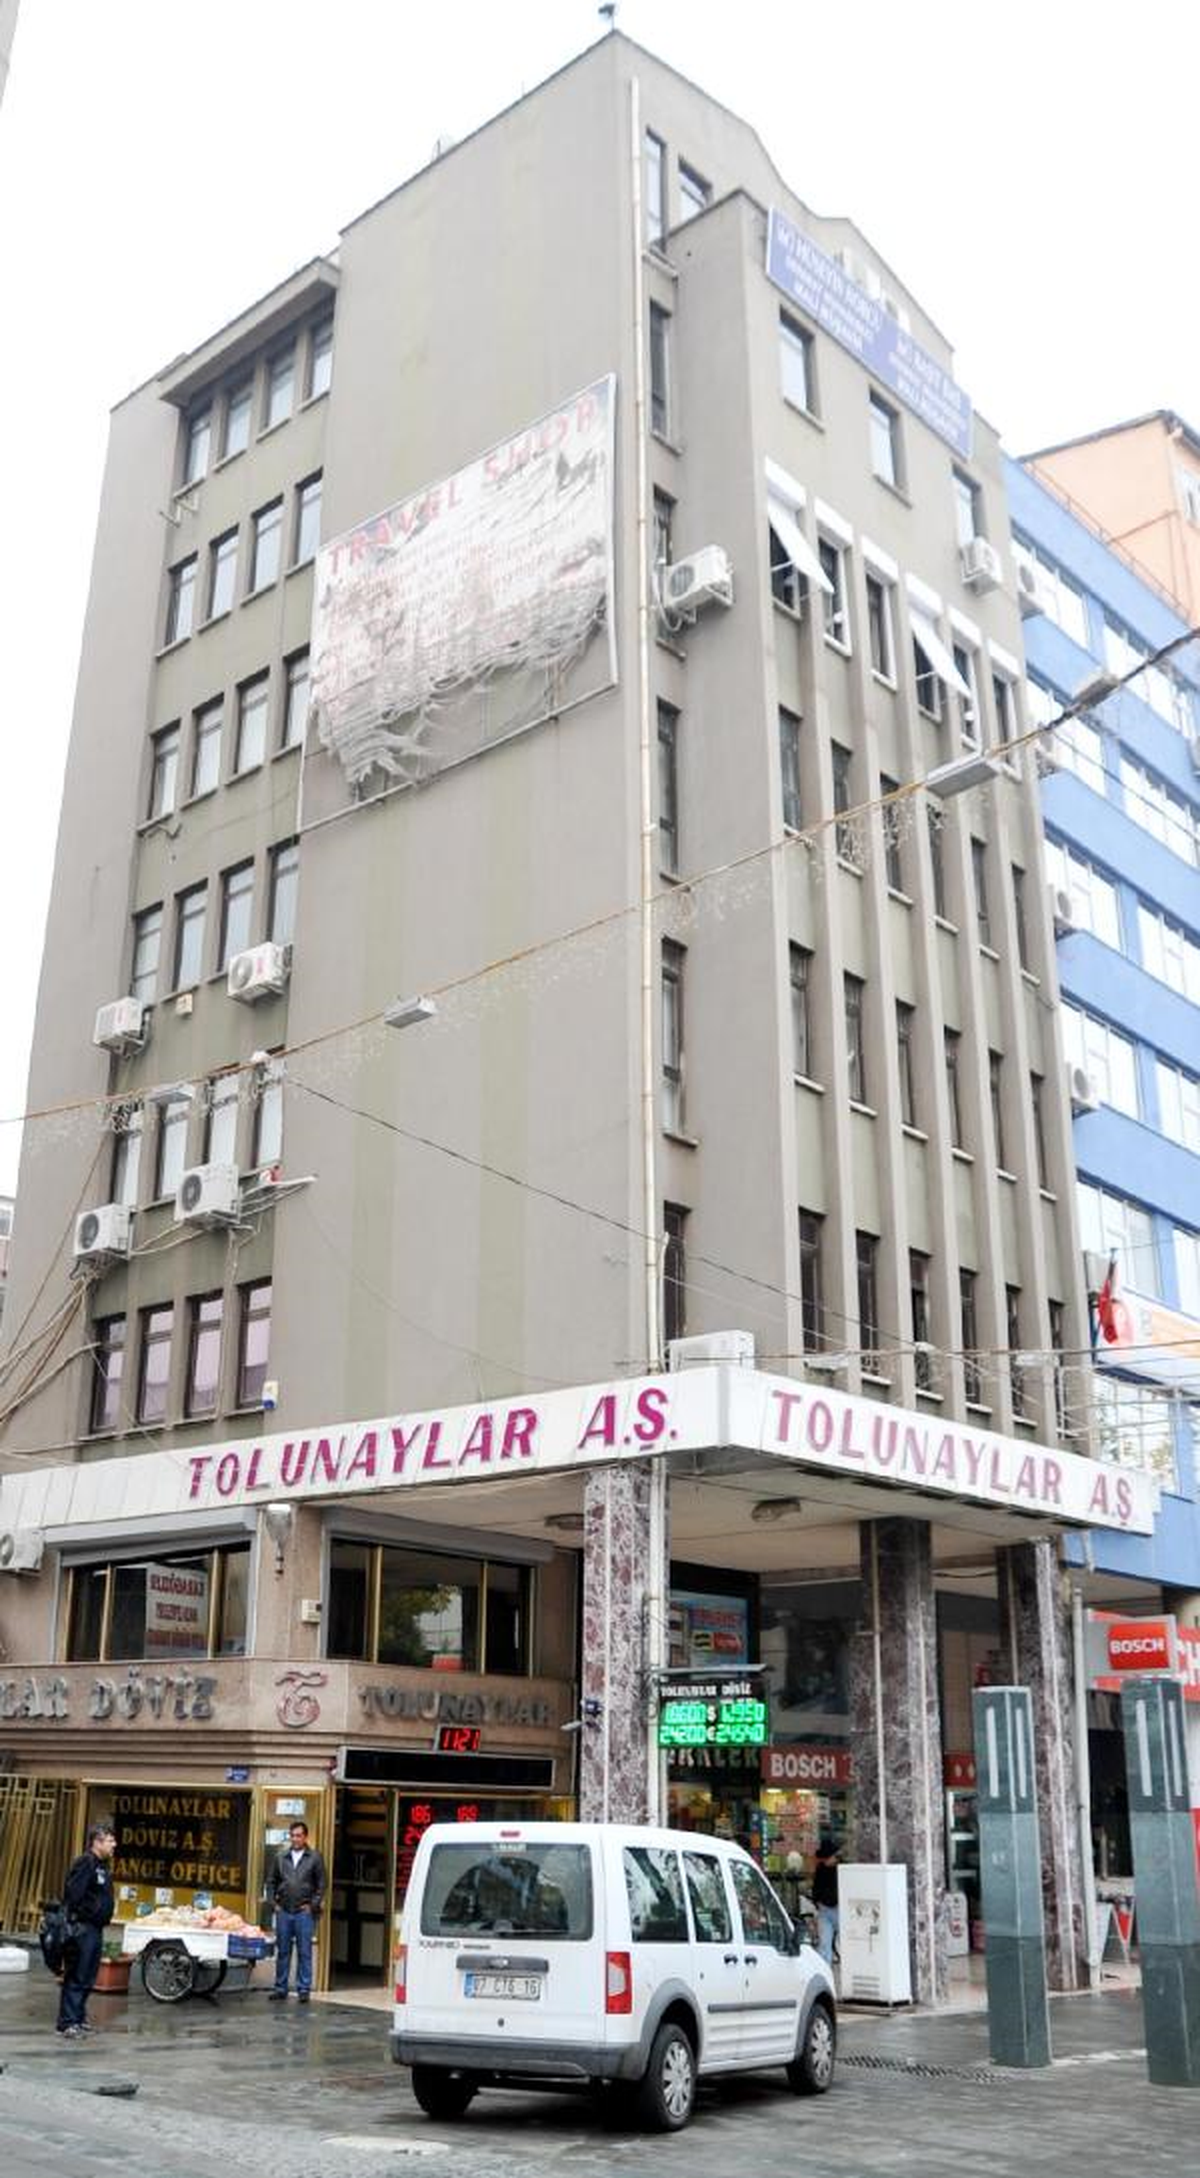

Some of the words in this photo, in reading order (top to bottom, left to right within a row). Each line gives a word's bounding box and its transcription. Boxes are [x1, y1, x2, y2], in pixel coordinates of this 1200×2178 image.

[328, 478, 463, 574] TRAVEL
[188, 1407, 538, 1498] TOLUNAYLAR
[578, 1387, 678, 1451] A.Ş.
[772, 1389, 1062, 1504] TOLUNAYLAR
[1110, 1637, 1166, 1655] BOSCH
[90, 1664, 217, 1719] DÖVİZ
[356, 1684, 556, 1726] TOLUNAYLAR
[770, 1753, 836, 1779] BOSCH
[112, 1794, 231, 1819] TOLUNAYLAR
[122, 1824, 177, 1848] DÖVİZ
[170, 1860, 241, 1887] OFFICE
